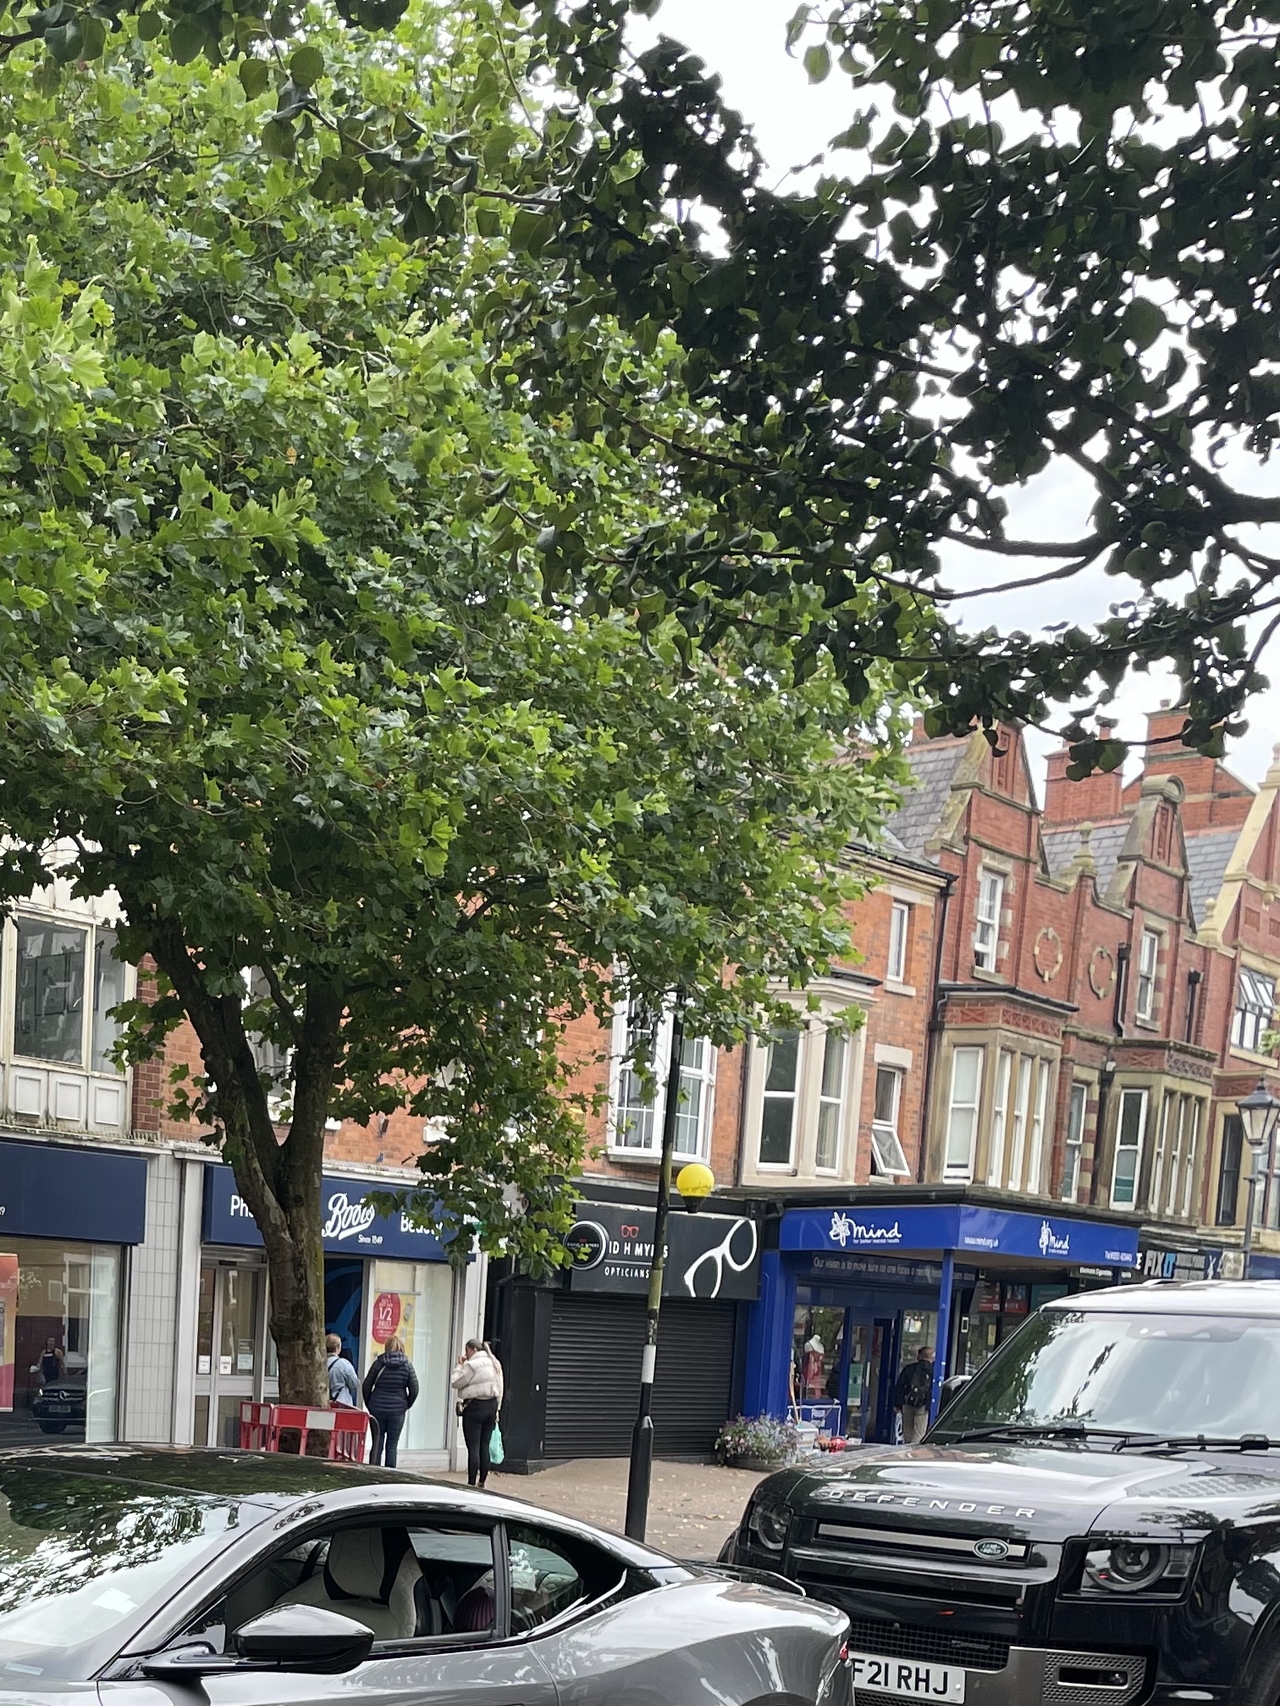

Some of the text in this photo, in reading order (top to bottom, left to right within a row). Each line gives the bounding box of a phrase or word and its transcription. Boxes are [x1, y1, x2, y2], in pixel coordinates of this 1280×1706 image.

[604, 1266, 650, 1279] OPTICIANS
[828, 1490, 1036, 1519] DEFENDER
[850, 1658, 949, 1696] F21 RHJ
